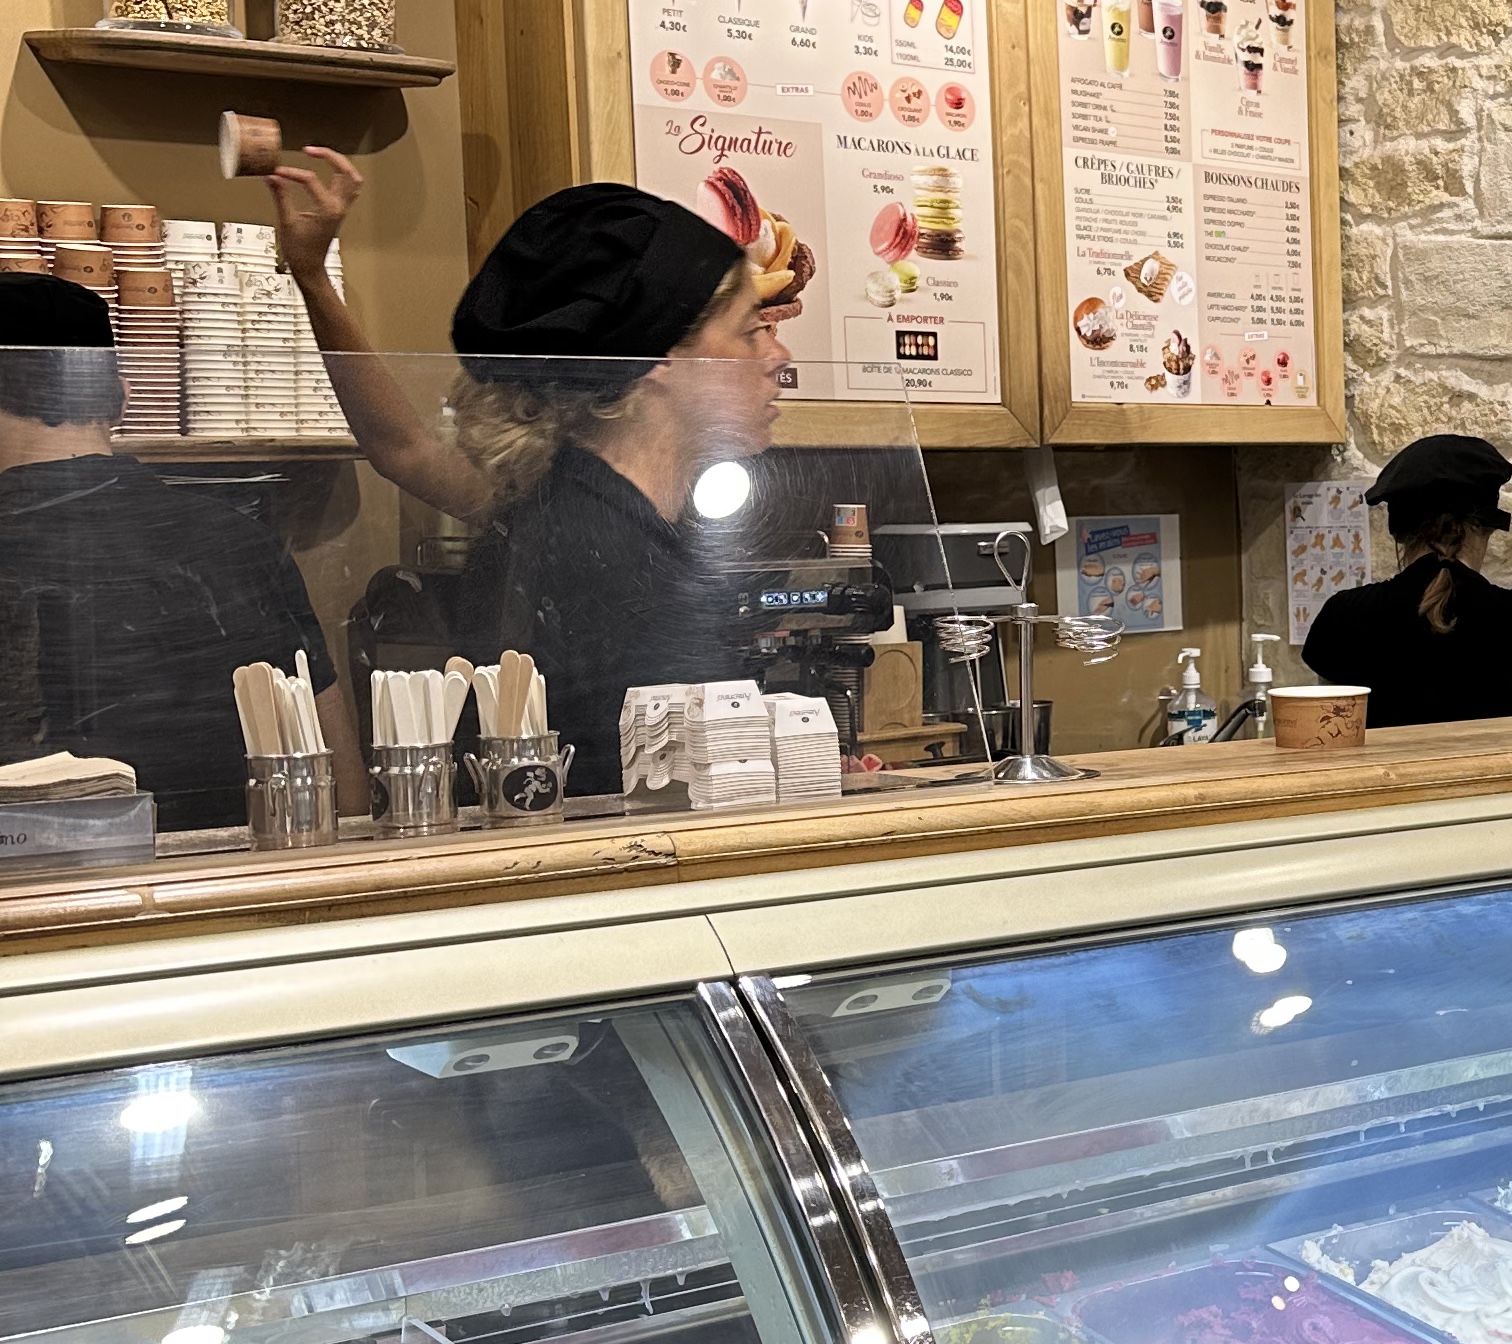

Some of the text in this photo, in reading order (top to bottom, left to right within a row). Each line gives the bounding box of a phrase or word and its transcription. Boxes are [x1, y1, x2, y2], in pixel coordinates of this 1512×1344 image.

[662, 8, 684, 18] PETIT
[717, 15, 760, 28] CLASSIQUE
[789, 25, 817, 36] GRAND
[857, 34, 874, 43] KIDS
[1195, 50, 1201, 60] &
[1272, 63, 1278, 72] &
[781, 86, 809, 94] EXTRAS
[1238, 107, 1244, 116] &
[1093, 115, 1103, 123] TEA
[665, 115, 797, 164] La Signature
[836, 134, 979, 162] MACARONS À LA GLACE
[1074, 154, 1174, 179] CRÊPES GAUFRES
[861, 167, 905, 182] Grandioso
[1204, 171, 1300, 194] BOISSONS CHAUDES
[1074, 187, 1091, 195] SUCRE
[1077, 246, 1086, 258] La
[925, 275, 959, 289] Classico
[887, 311, 945, 325] À EMPORTER
[1116, 310, 1125, 320] La
[883, 366, 892, 374] DE
[902, 367, 940, 376] MACARONS
[941, 367, 973, 377] CLASSICO
[905, 379, 932, 388] 20,90€
